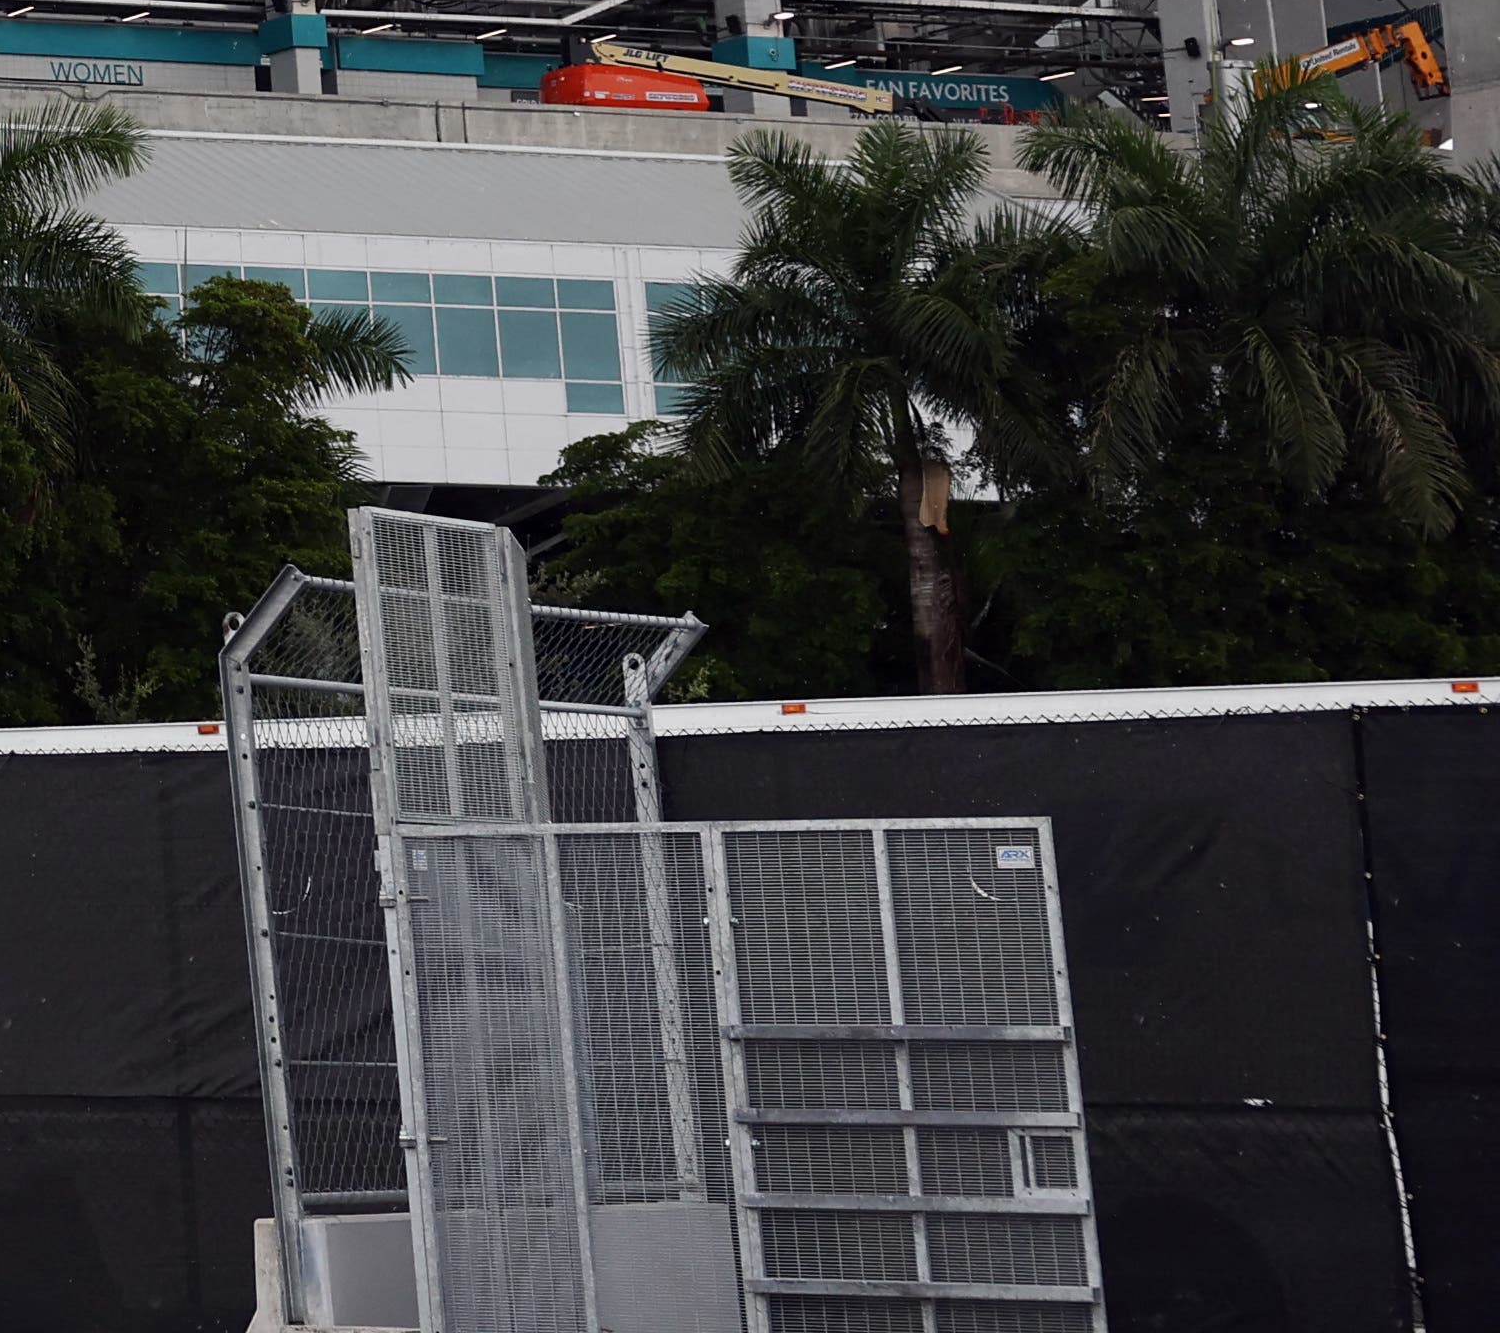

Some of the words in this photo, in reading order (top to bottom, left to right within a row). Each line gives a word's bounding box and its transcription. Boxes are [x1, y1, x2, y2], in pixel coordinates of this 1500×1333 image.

[623, 48, 642, 59] JLG
[645, 52, 669, 64] LIFT
[49, 61, 144, 86] WOMEN
[865, 79, 904, 99] FAN
[908, 83, 1010, 103] FAVORITES
[1001, 850, 1029, 858] ARX
